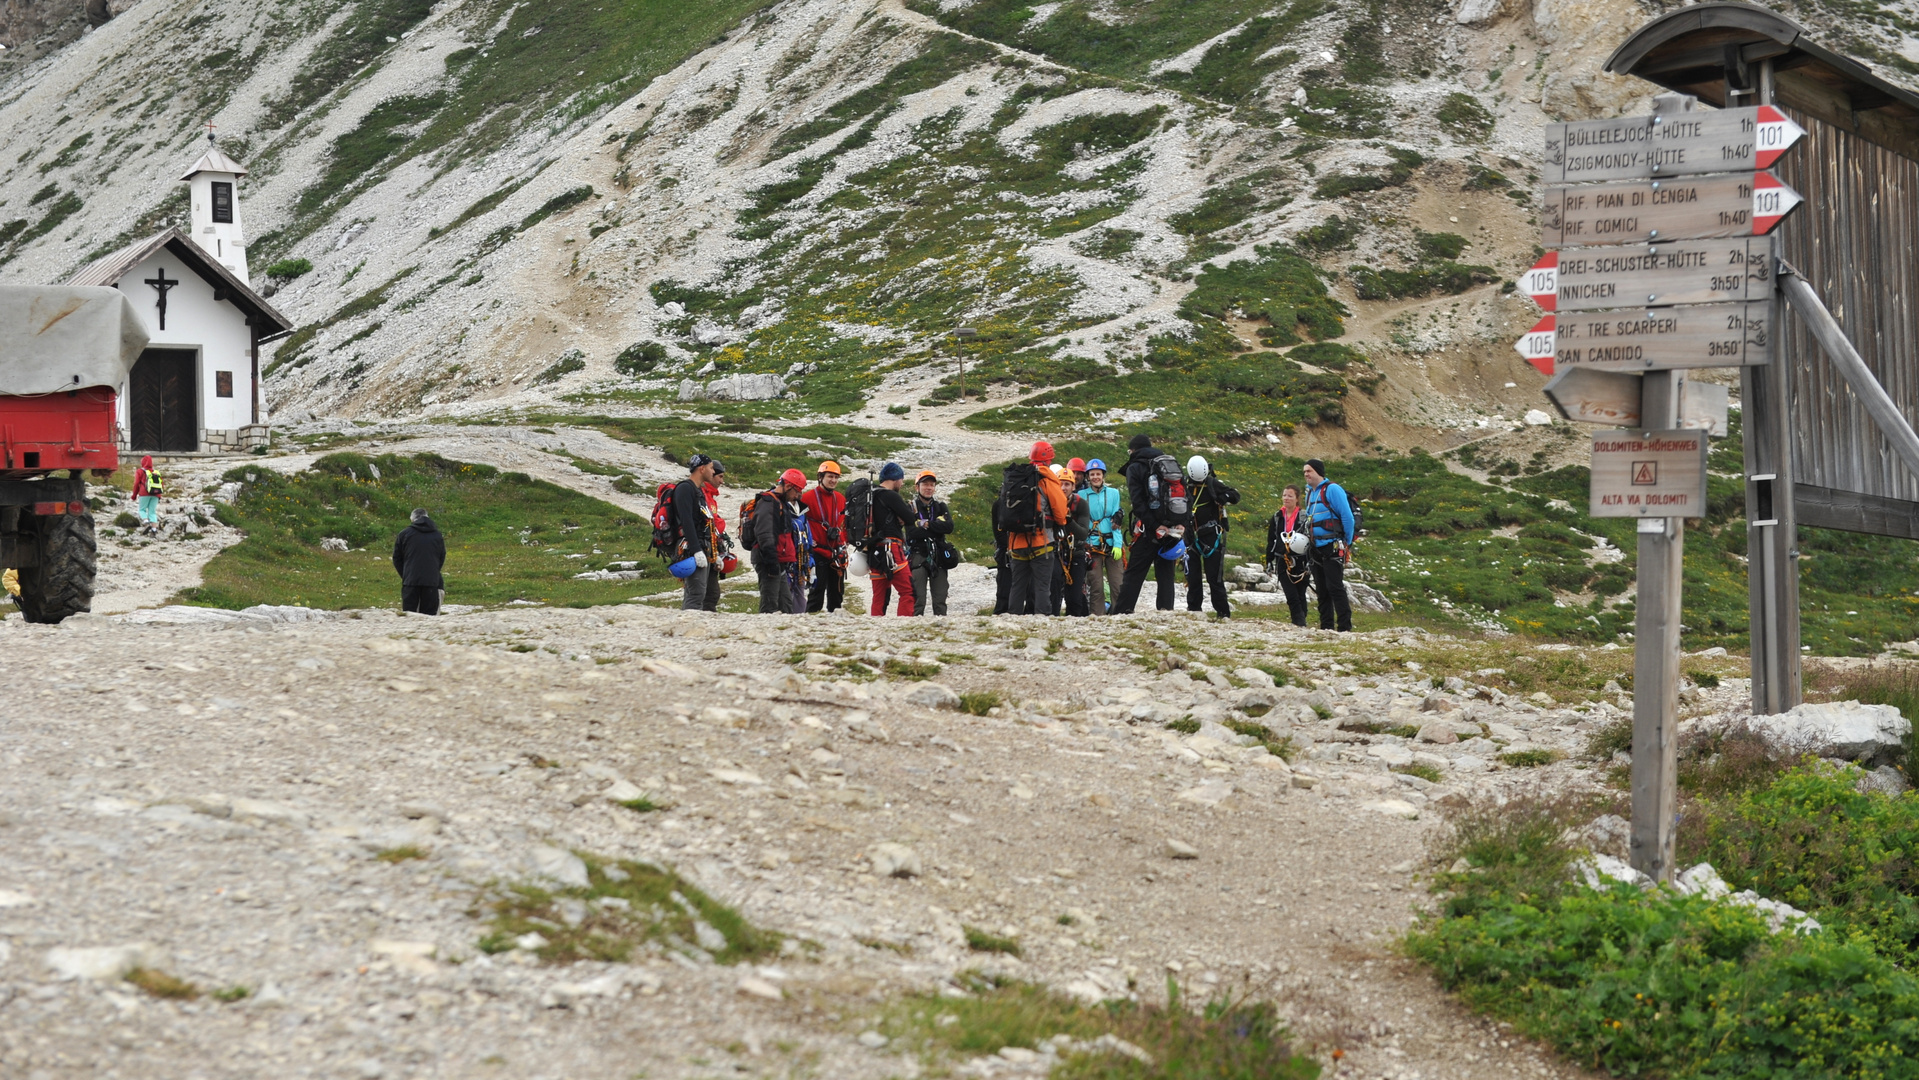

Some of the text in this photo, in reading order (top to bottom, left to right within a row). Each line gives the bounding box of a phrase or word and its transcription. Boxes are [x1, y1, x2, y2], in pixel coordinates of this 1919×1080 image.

[1568, 117, 1754, 147] BÜLLELEJOCH-HÜTTE 1h
[1760, 126, 1783, 146] 101
[1567, 148, 1686, 171] ZSIGMONDY-HÜTTE
[1566, 184, 1751, 211] RIF. PIAN DI CENGIA 1h
[1757, 192, 1780, 212] 101
[1565, 219, 1587, 235] RIF.
[1595, 217, 1638, 234] COMICI
[1559, 249, 1744, 276] DREI-SCHUSTER-HÜTTE 2h
[1530, 272, 1555, 292] 105
[1559, 282, 1616, 300] INNICHEN
[1557, 315, 1742, 339] RIF. TRE SCARPERI 2h
[1527, 335, 1553, 355] 105
[1557, 349, 1581, 364] SAN
[1588, 345, 1643, 362] CANDIDO
[1594, 438, 1698, 453] DOLOMITEN-HÖHENWEG
[1601, 494, 1688, 505] ALTA VIA DOLOMITI
